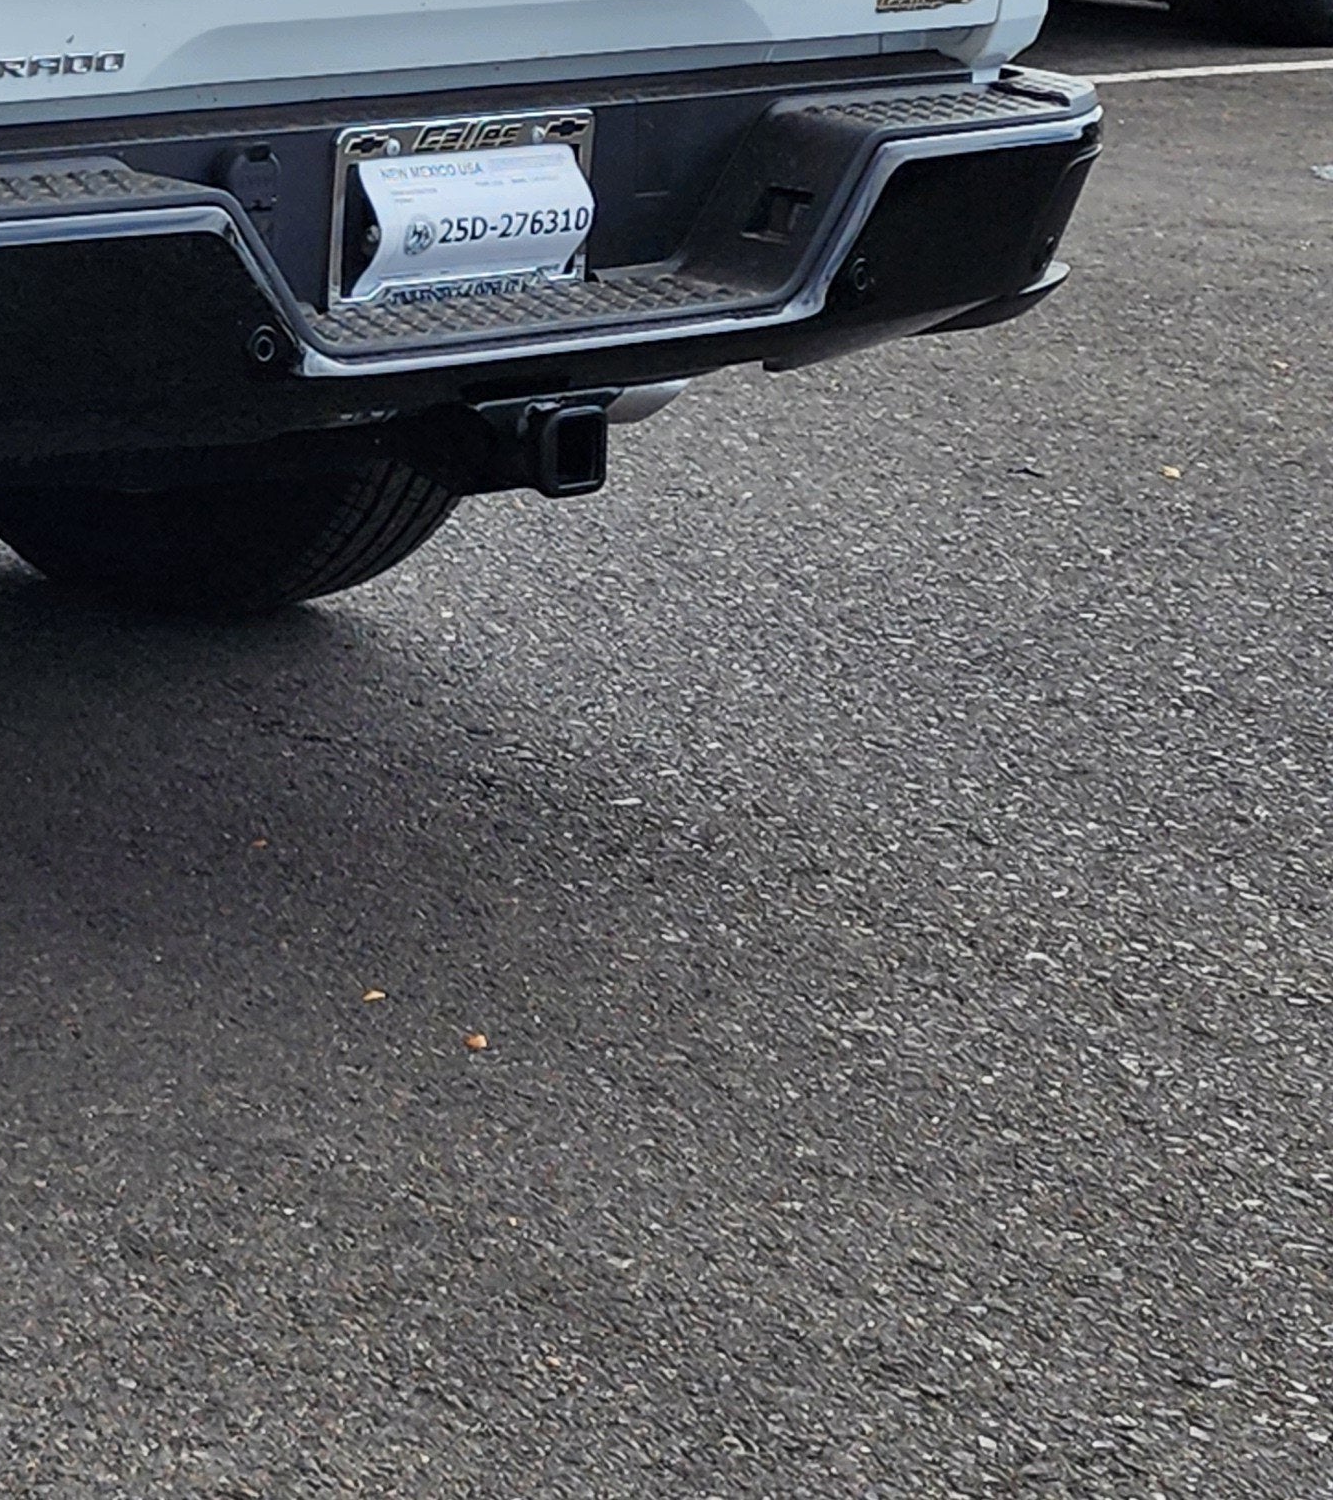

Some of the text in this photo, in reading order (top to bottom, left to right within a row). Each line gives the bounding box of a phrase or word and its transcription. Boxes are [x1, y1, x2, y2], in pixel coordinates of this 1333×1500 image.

[410, 164, 455, 179] MEXICO
[458, 162, 483, 177] USA
[438, 207, 590, 244] 25D-276310
